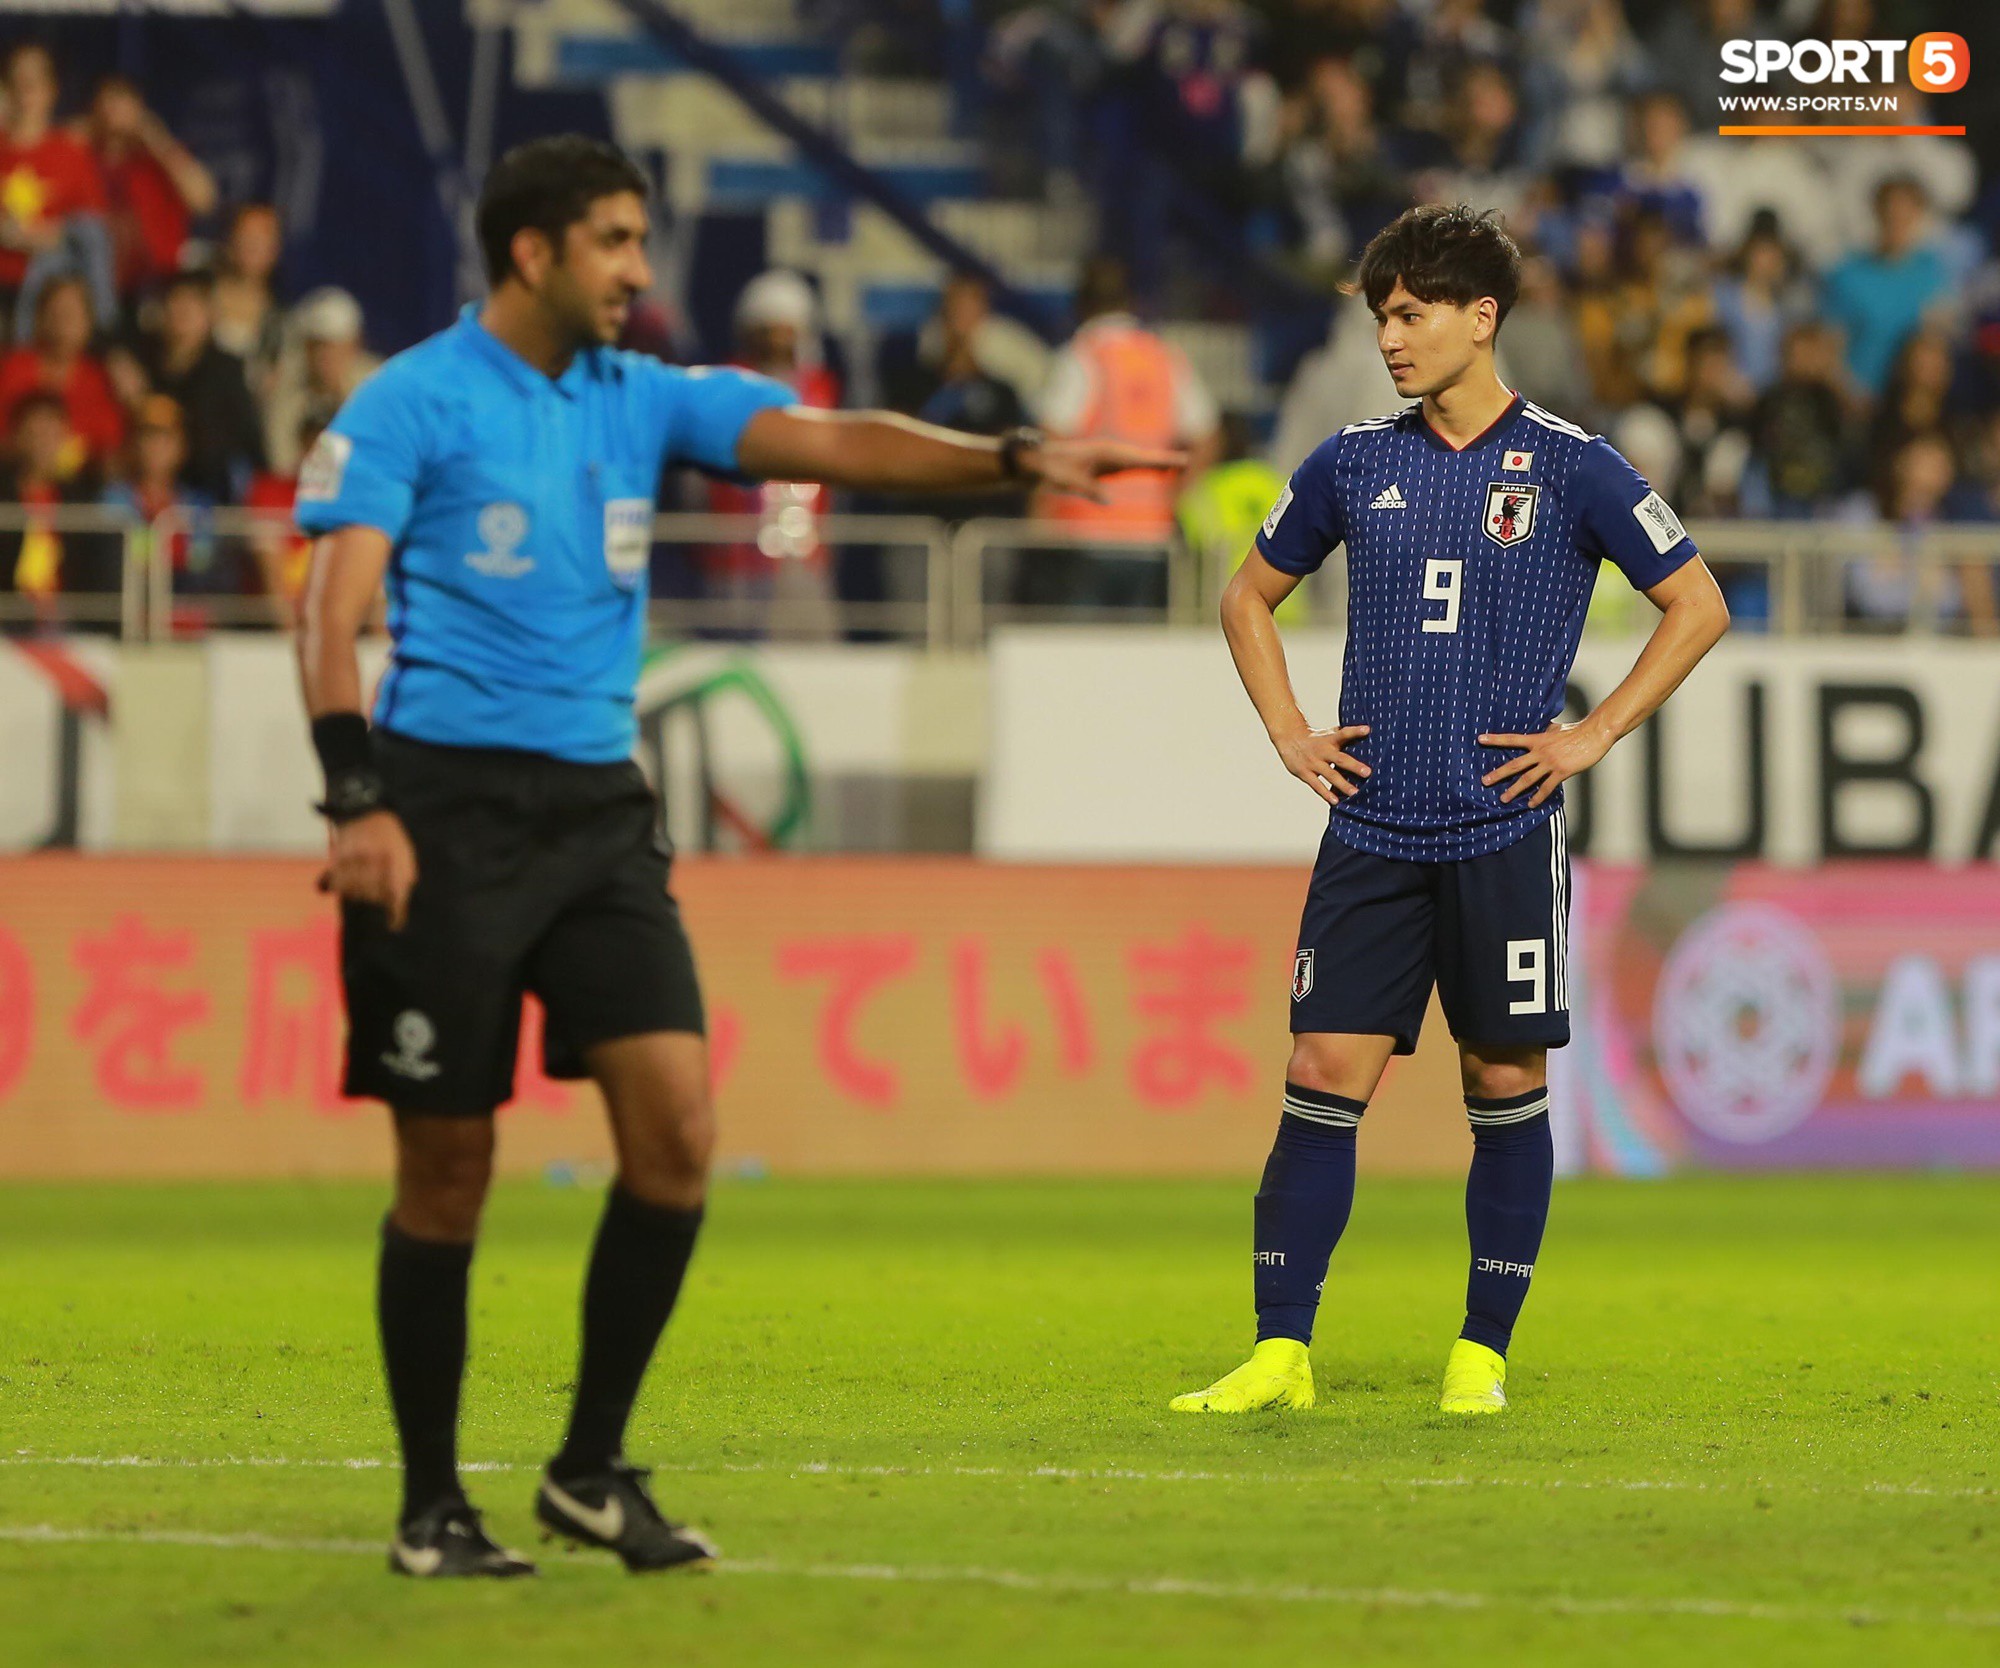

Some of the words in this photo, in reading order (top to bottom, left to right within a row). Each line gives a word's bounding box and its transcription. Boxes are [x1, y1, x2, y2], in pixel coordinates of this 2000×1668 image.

[1500, 485, 1526, 493] JAPAN
[1370, 499, 1407, 510] adidas
[1422, 559, 1463, 634] 9
[1506, 938, 1547, 1015] 9
[1477, 1257, 1534, 1278] JAPAN
